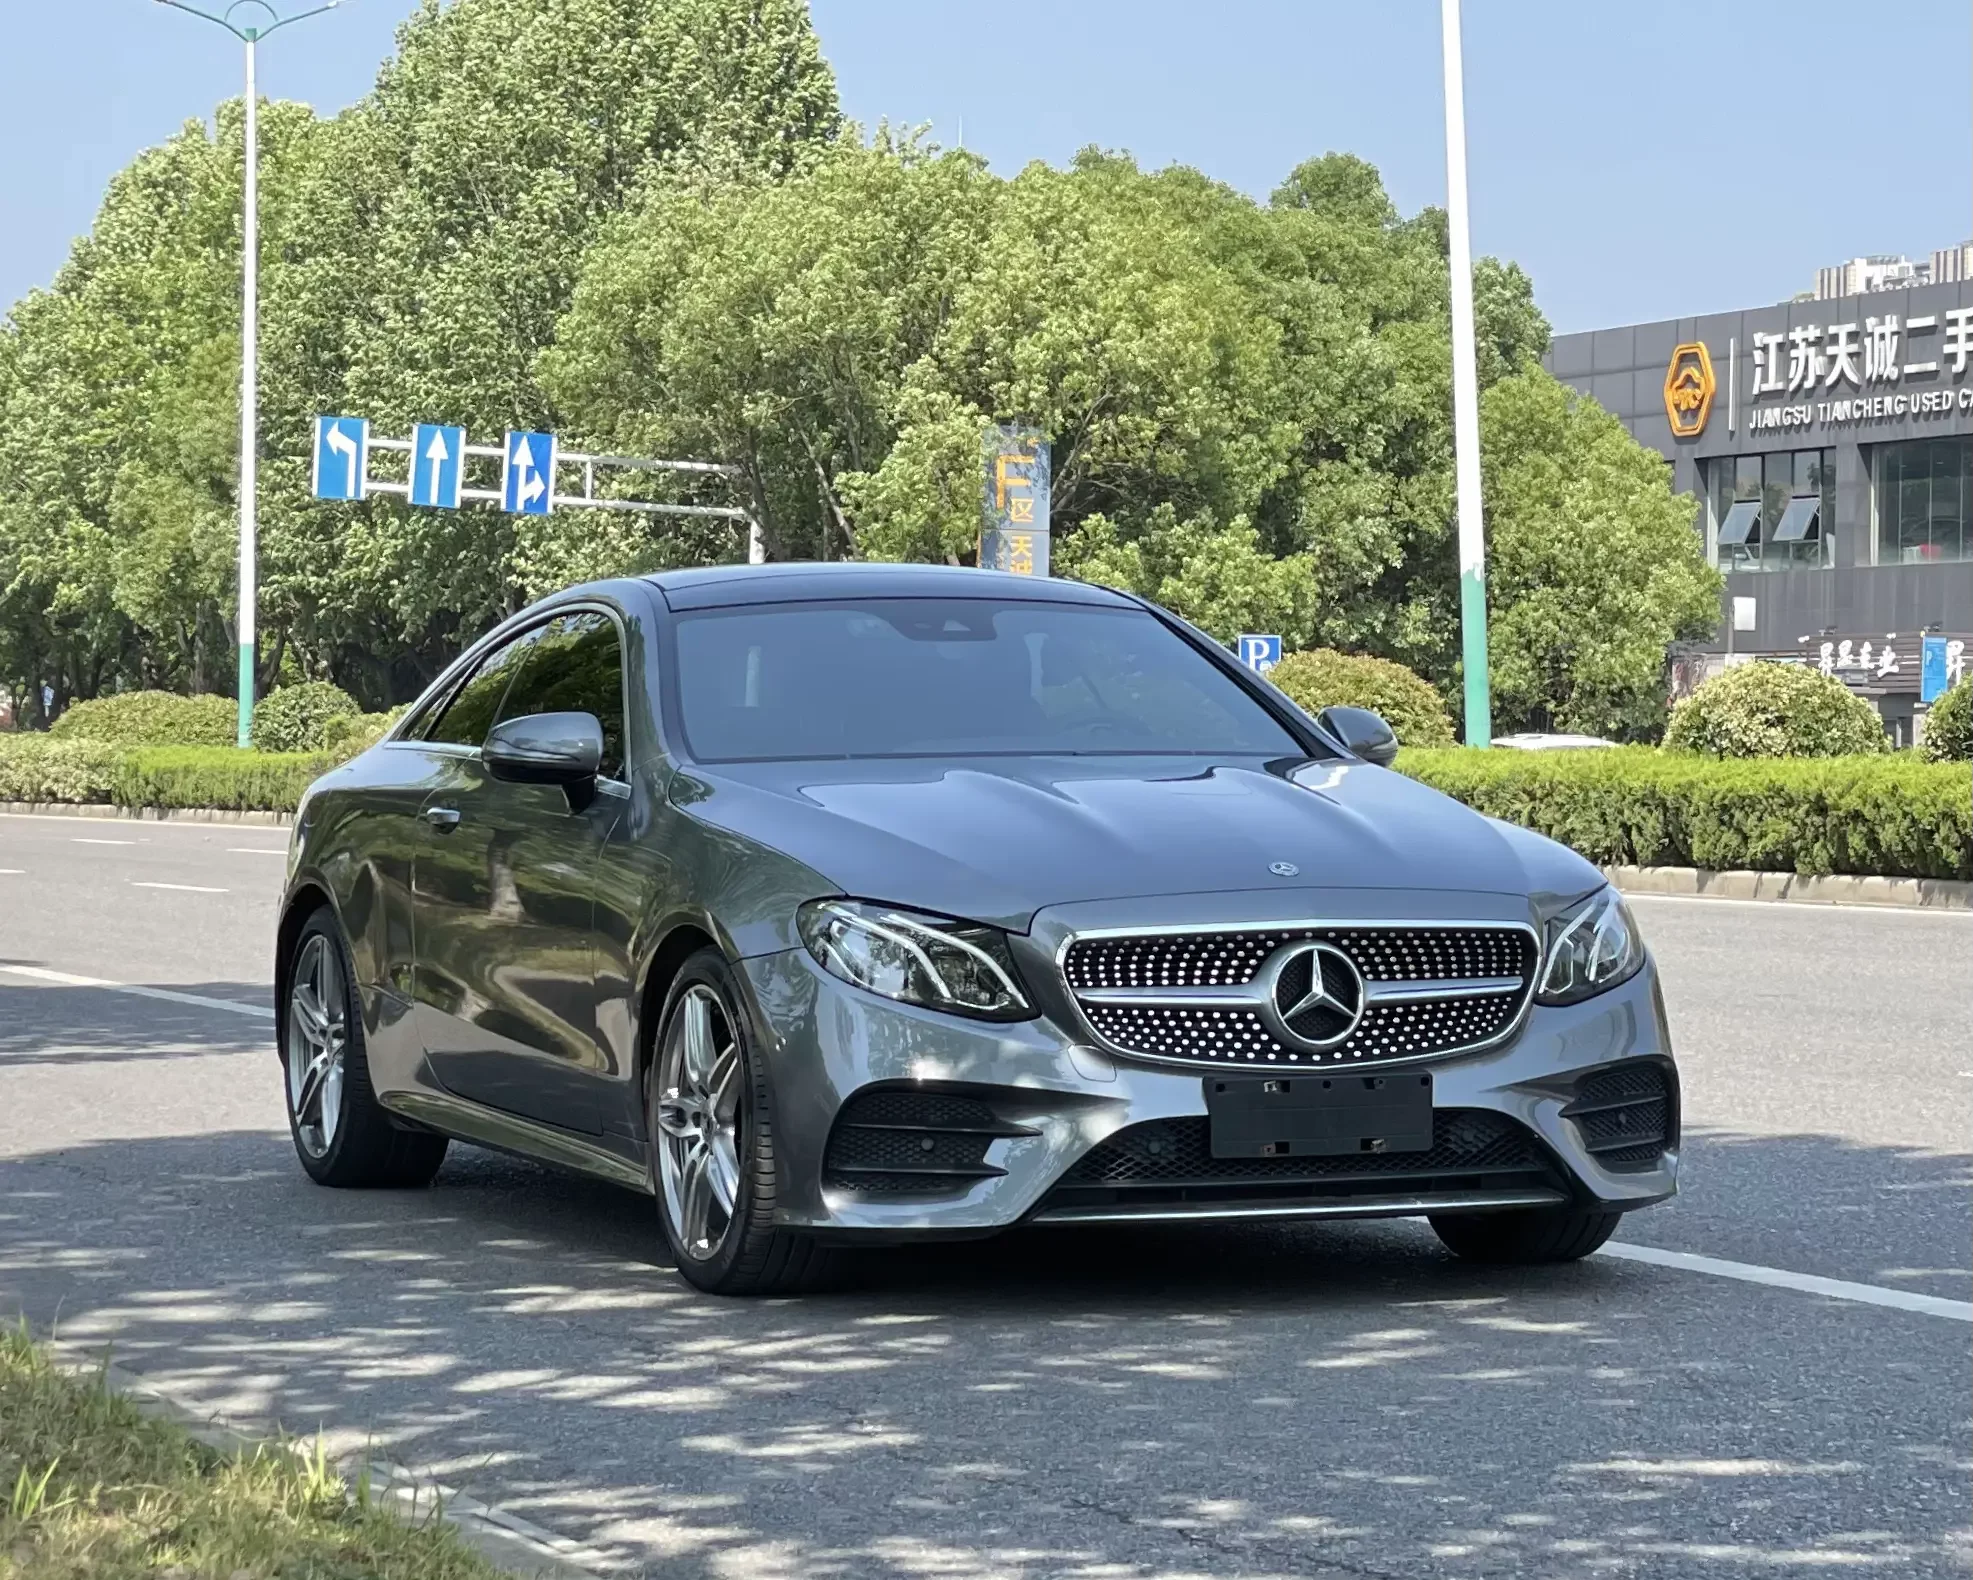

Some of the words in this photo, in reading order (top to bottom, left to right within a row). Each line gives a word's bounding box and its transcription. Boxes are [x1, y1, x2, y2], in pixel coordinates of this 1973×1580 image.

[1752, 306, 1973, 395] 江苏天诚二手
[1749, 404, 1812, 429] JIANGSU
[1818, 395, 1908, 422] TIANCHENG
[1911, 390, 1955, 413] USED
[1245, 639, 1270, 672] P
